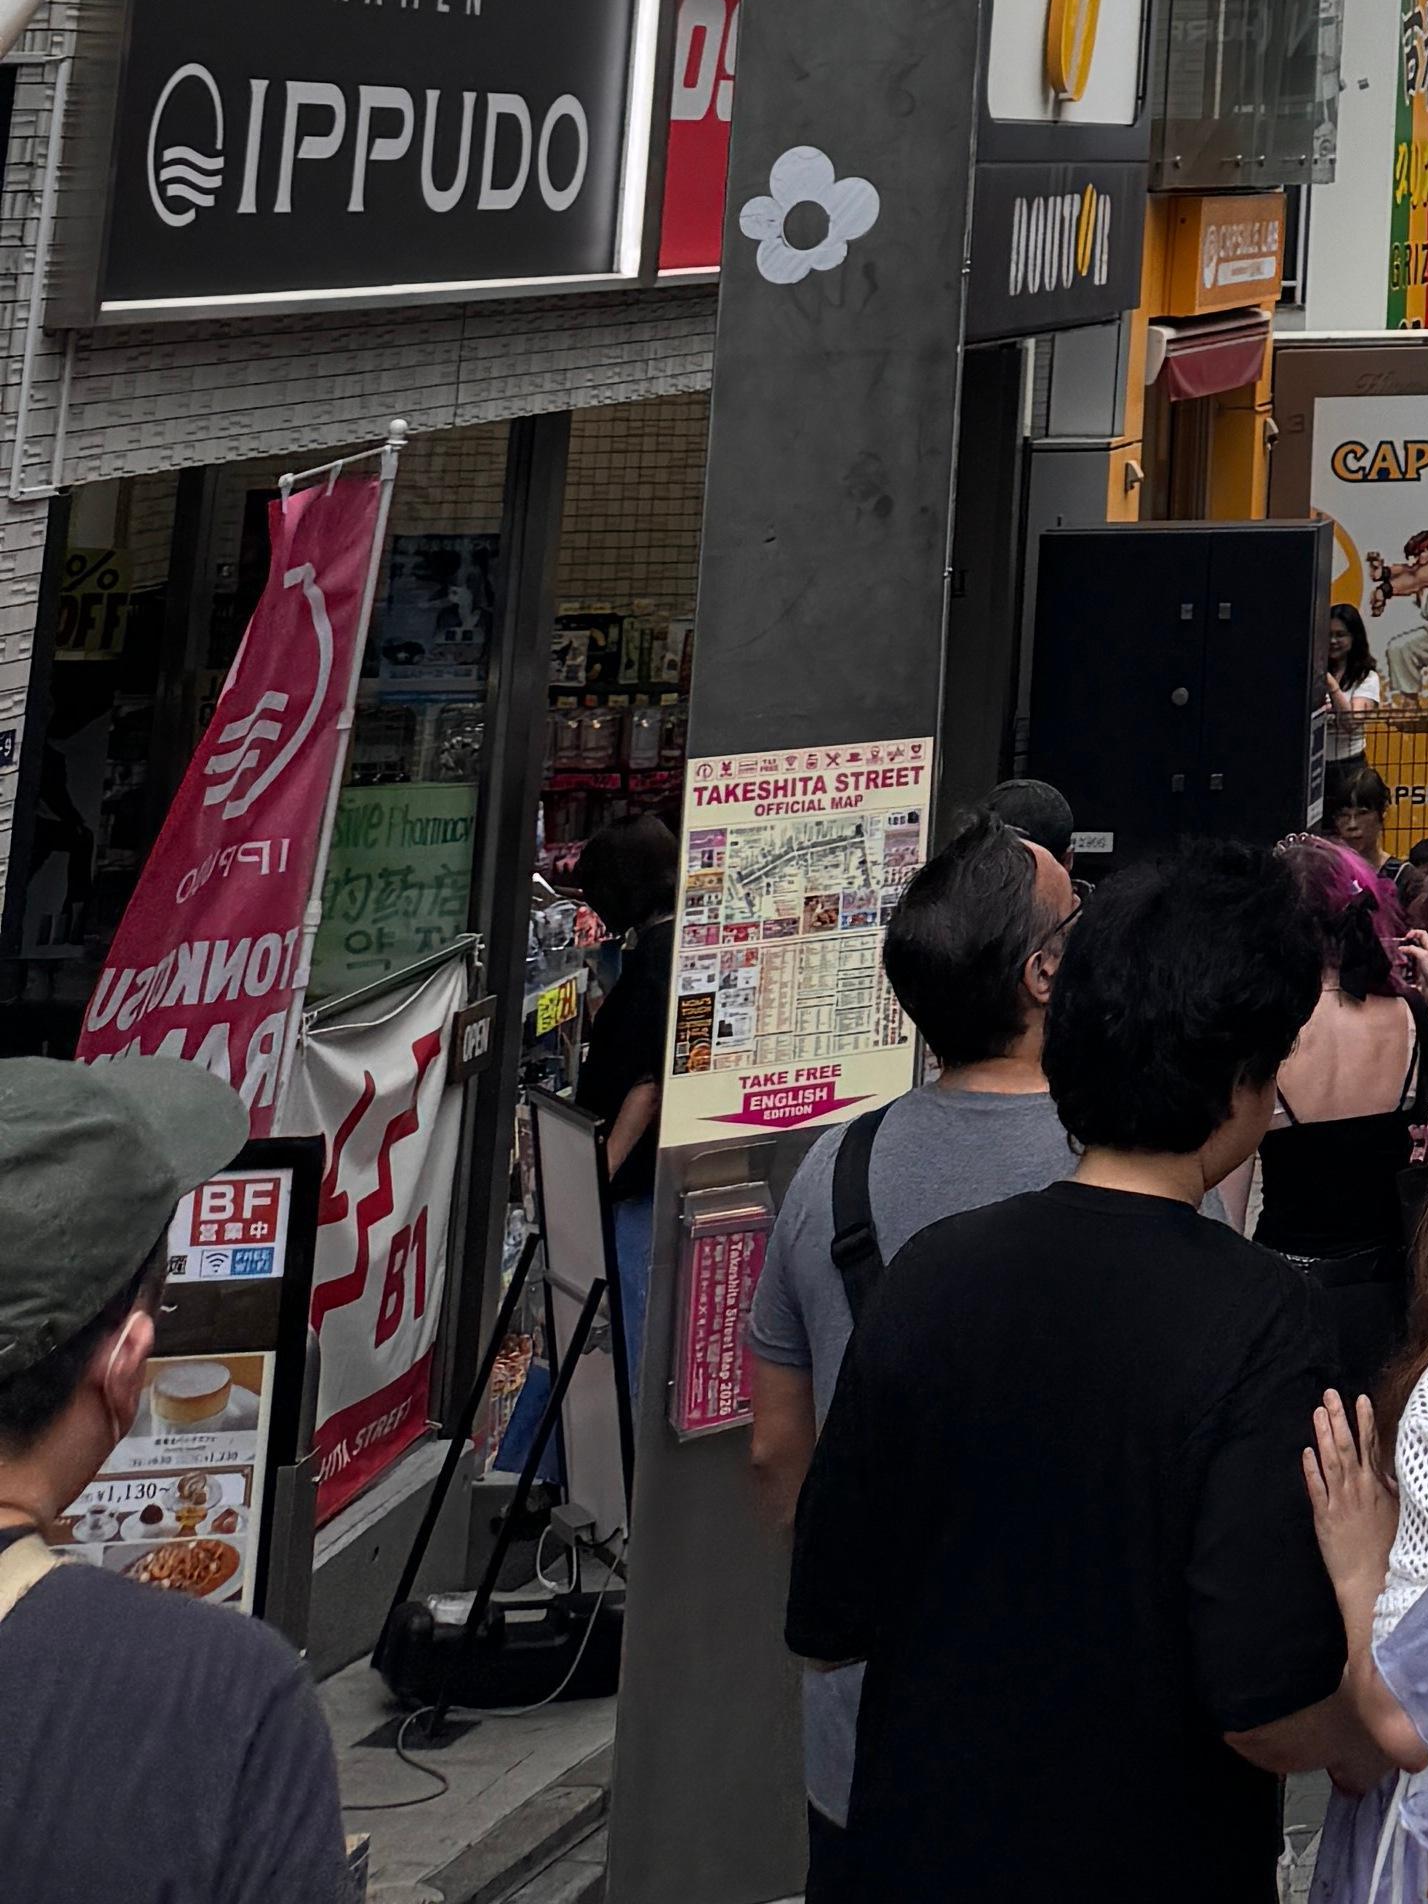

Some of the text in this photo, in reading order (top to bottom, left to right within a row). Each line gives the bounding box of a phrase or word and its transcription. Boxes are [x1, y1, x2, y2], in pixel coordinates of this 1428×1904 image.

[236, 76, 589, 215] IPPUDO
[692, 764, 926, 807] TAKESHITA STREET
[753, 793, 865, 817] OFFICIAL MAP
[462, 1016, 491, 1063] OPEN
[738, 1062, 843, 1090] TAKE FREE
[749, 1085, 829, 1112] ENGLISH
[762, 1104, 813, 1121] EDITION
[200, 1181, 275, 1222] BF
